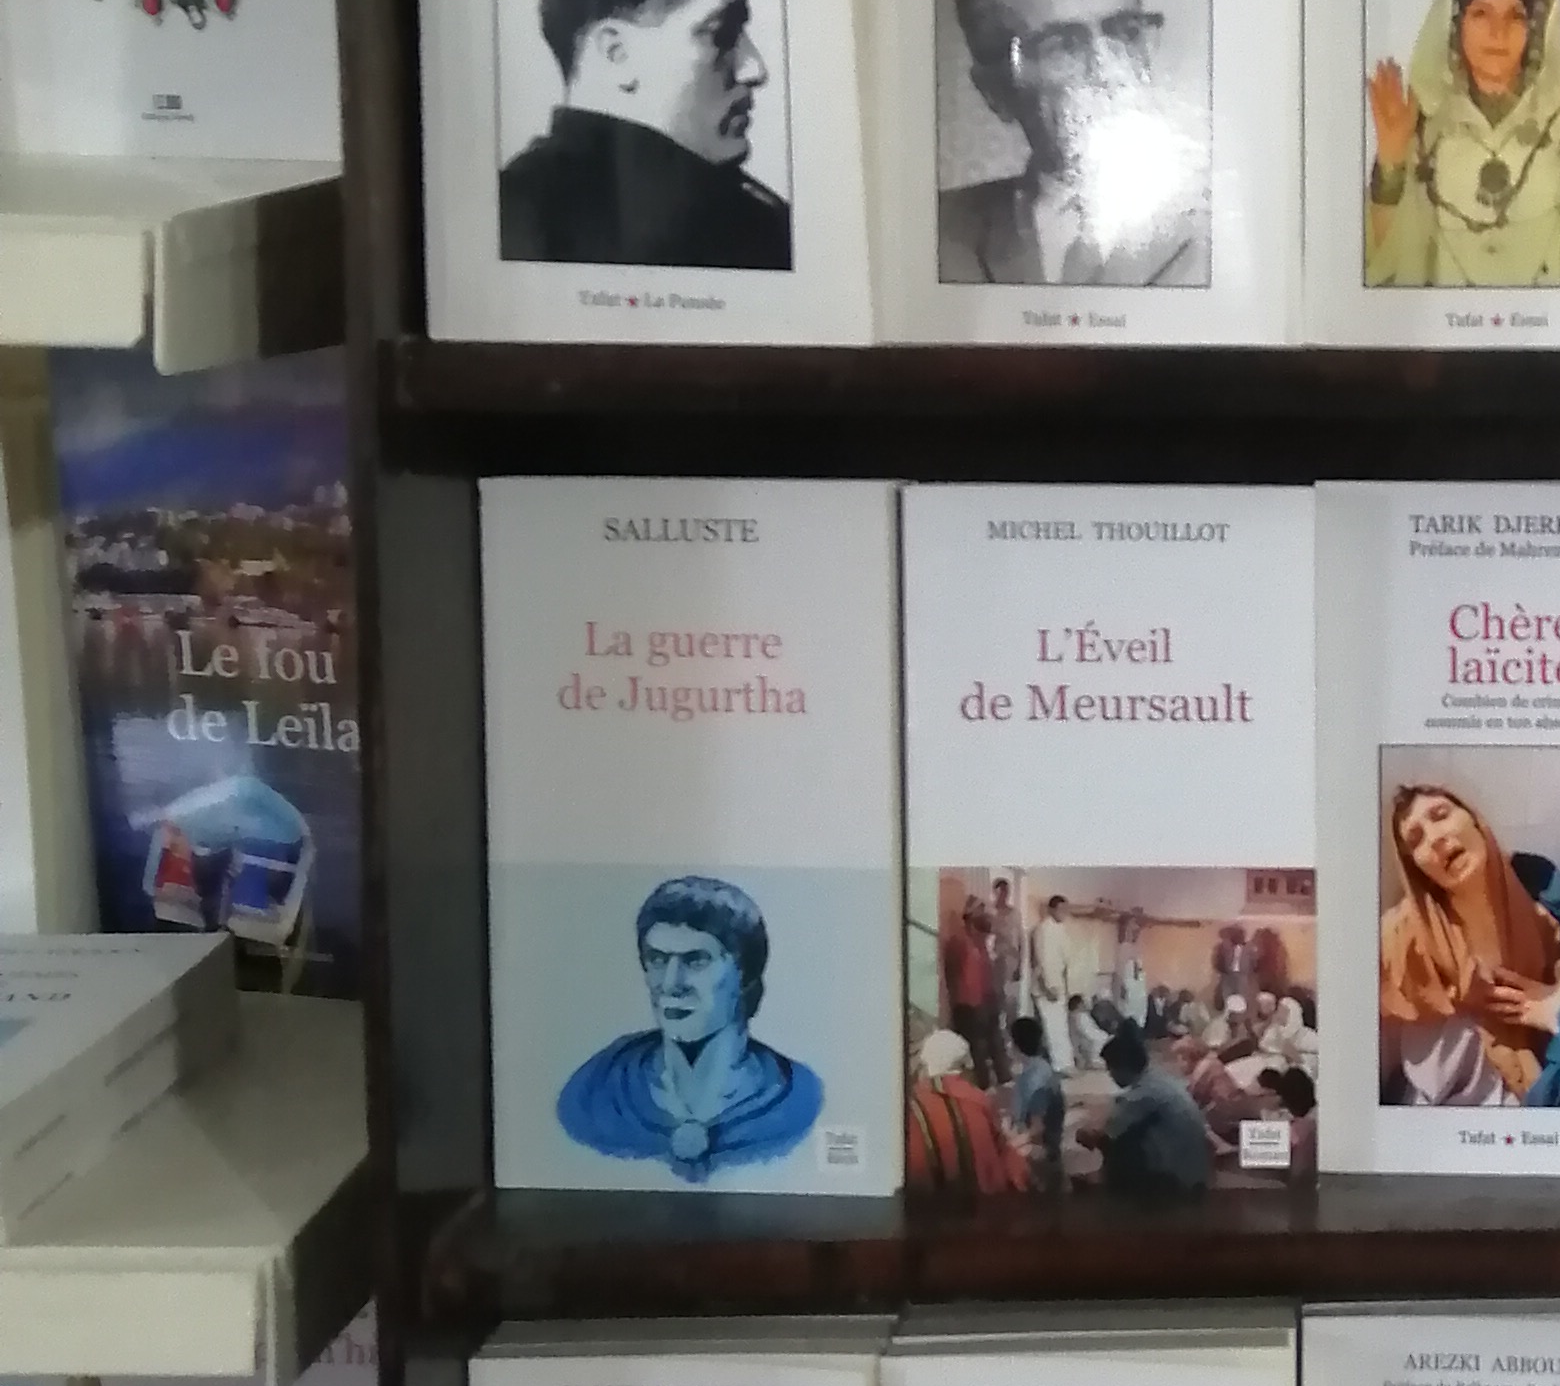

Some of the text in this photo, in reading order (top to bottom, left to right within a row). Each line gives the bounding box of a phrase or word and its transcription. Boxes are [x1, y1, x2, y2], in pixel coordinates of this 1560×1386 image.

[604, 517, 760, 542] SALLUSTE
[987, 520, 1082, 540] MICHEL
[1409, 514, 1482, 534] TARIK
[176, 631, 337, 685] Le fou
[585, 621, 782, 666] La guerre
[1037, 619, 1174, 663] L'Éveil
[558, 672, 807, 722] de Jugurtha
[960, 680, 1254, 722] de Meursault
[167, 693, 361, 753] de Leïla
